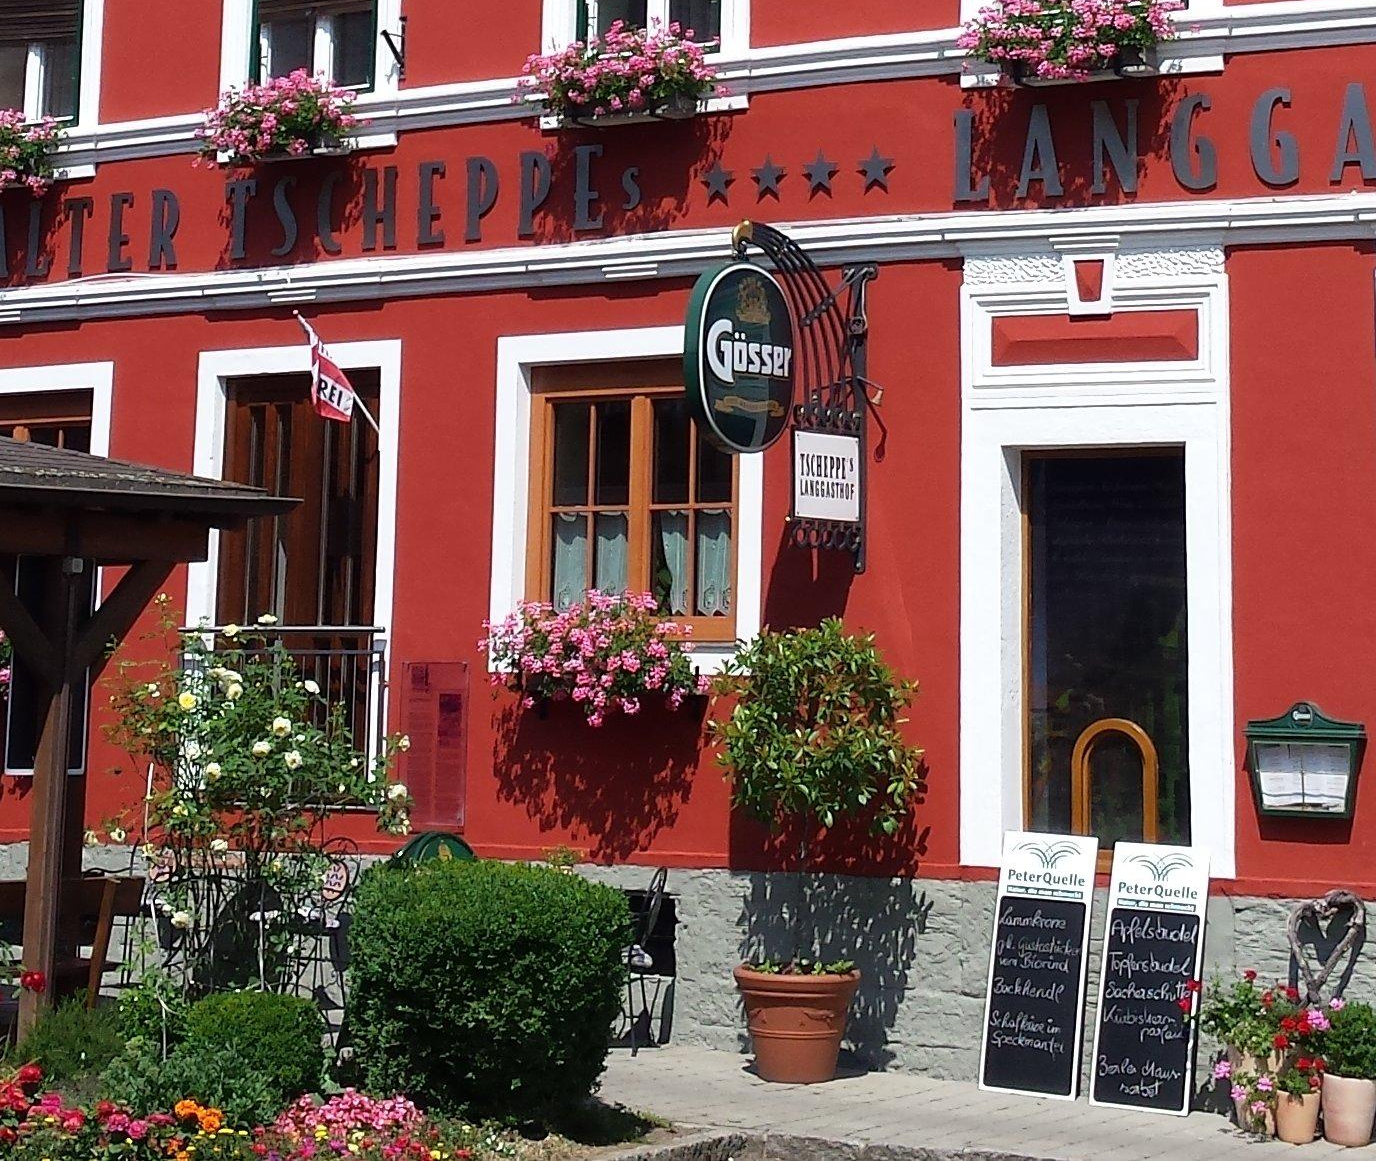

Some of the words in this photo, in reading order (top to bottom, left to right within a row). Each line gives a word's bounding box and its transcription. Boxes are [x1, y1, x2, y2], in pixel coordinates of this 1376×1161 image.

[707, 319, 792, 383] Gösser
[799, 479, 855, 500] LANGGASTHOF
[1008, 869, 1086, 887] PeterQuelle
[1118, 881, 1198, 899] PeterQuelle
